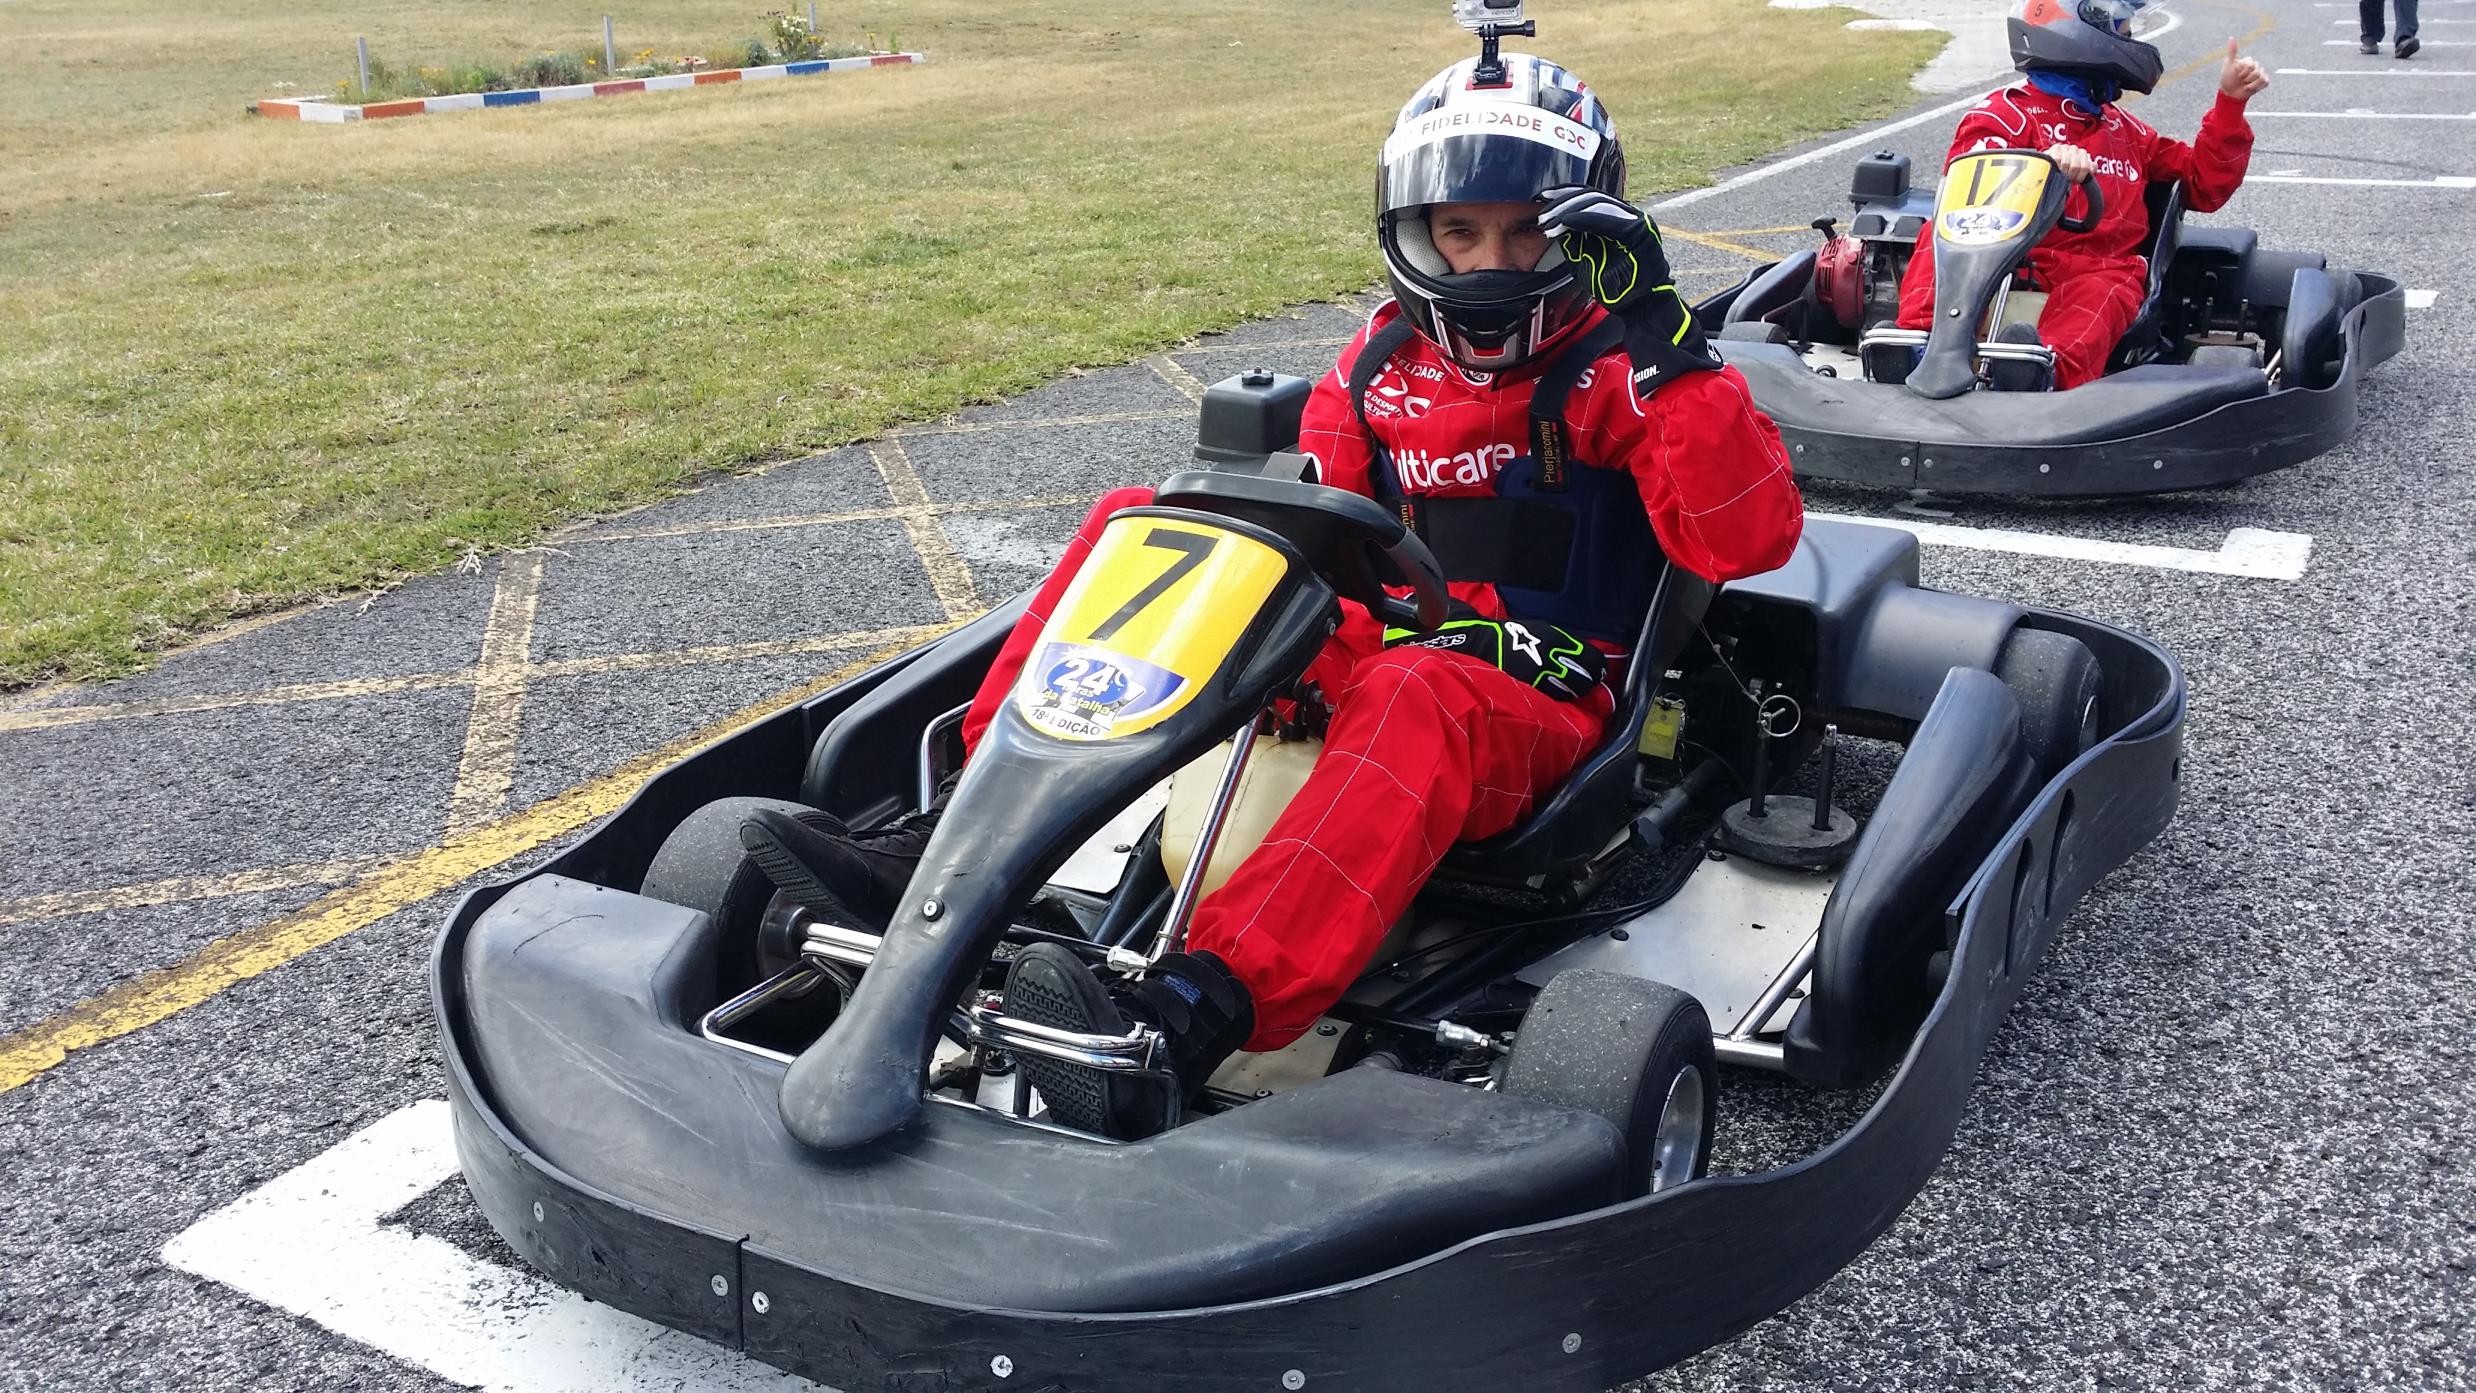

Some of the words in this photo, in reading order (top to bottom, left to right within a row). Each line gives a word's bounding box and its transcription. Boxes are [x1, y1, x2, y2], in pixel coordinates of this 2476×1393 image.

[2034, 4, 2044, 17] 5
[1421, 111, 1543, 136] FIDELIDADE
[1553, 125, 1586, 150] GDC
[1965, 158, 2029, 206] 17
[1389, 443, 1516, 489] ulticare
[1087, 527, 1220, 642] 7
[1052, 657, 1118, 697] 24
[1043, 689, 1059, 701] da
[1066, 695, 1112, 717] atalha
